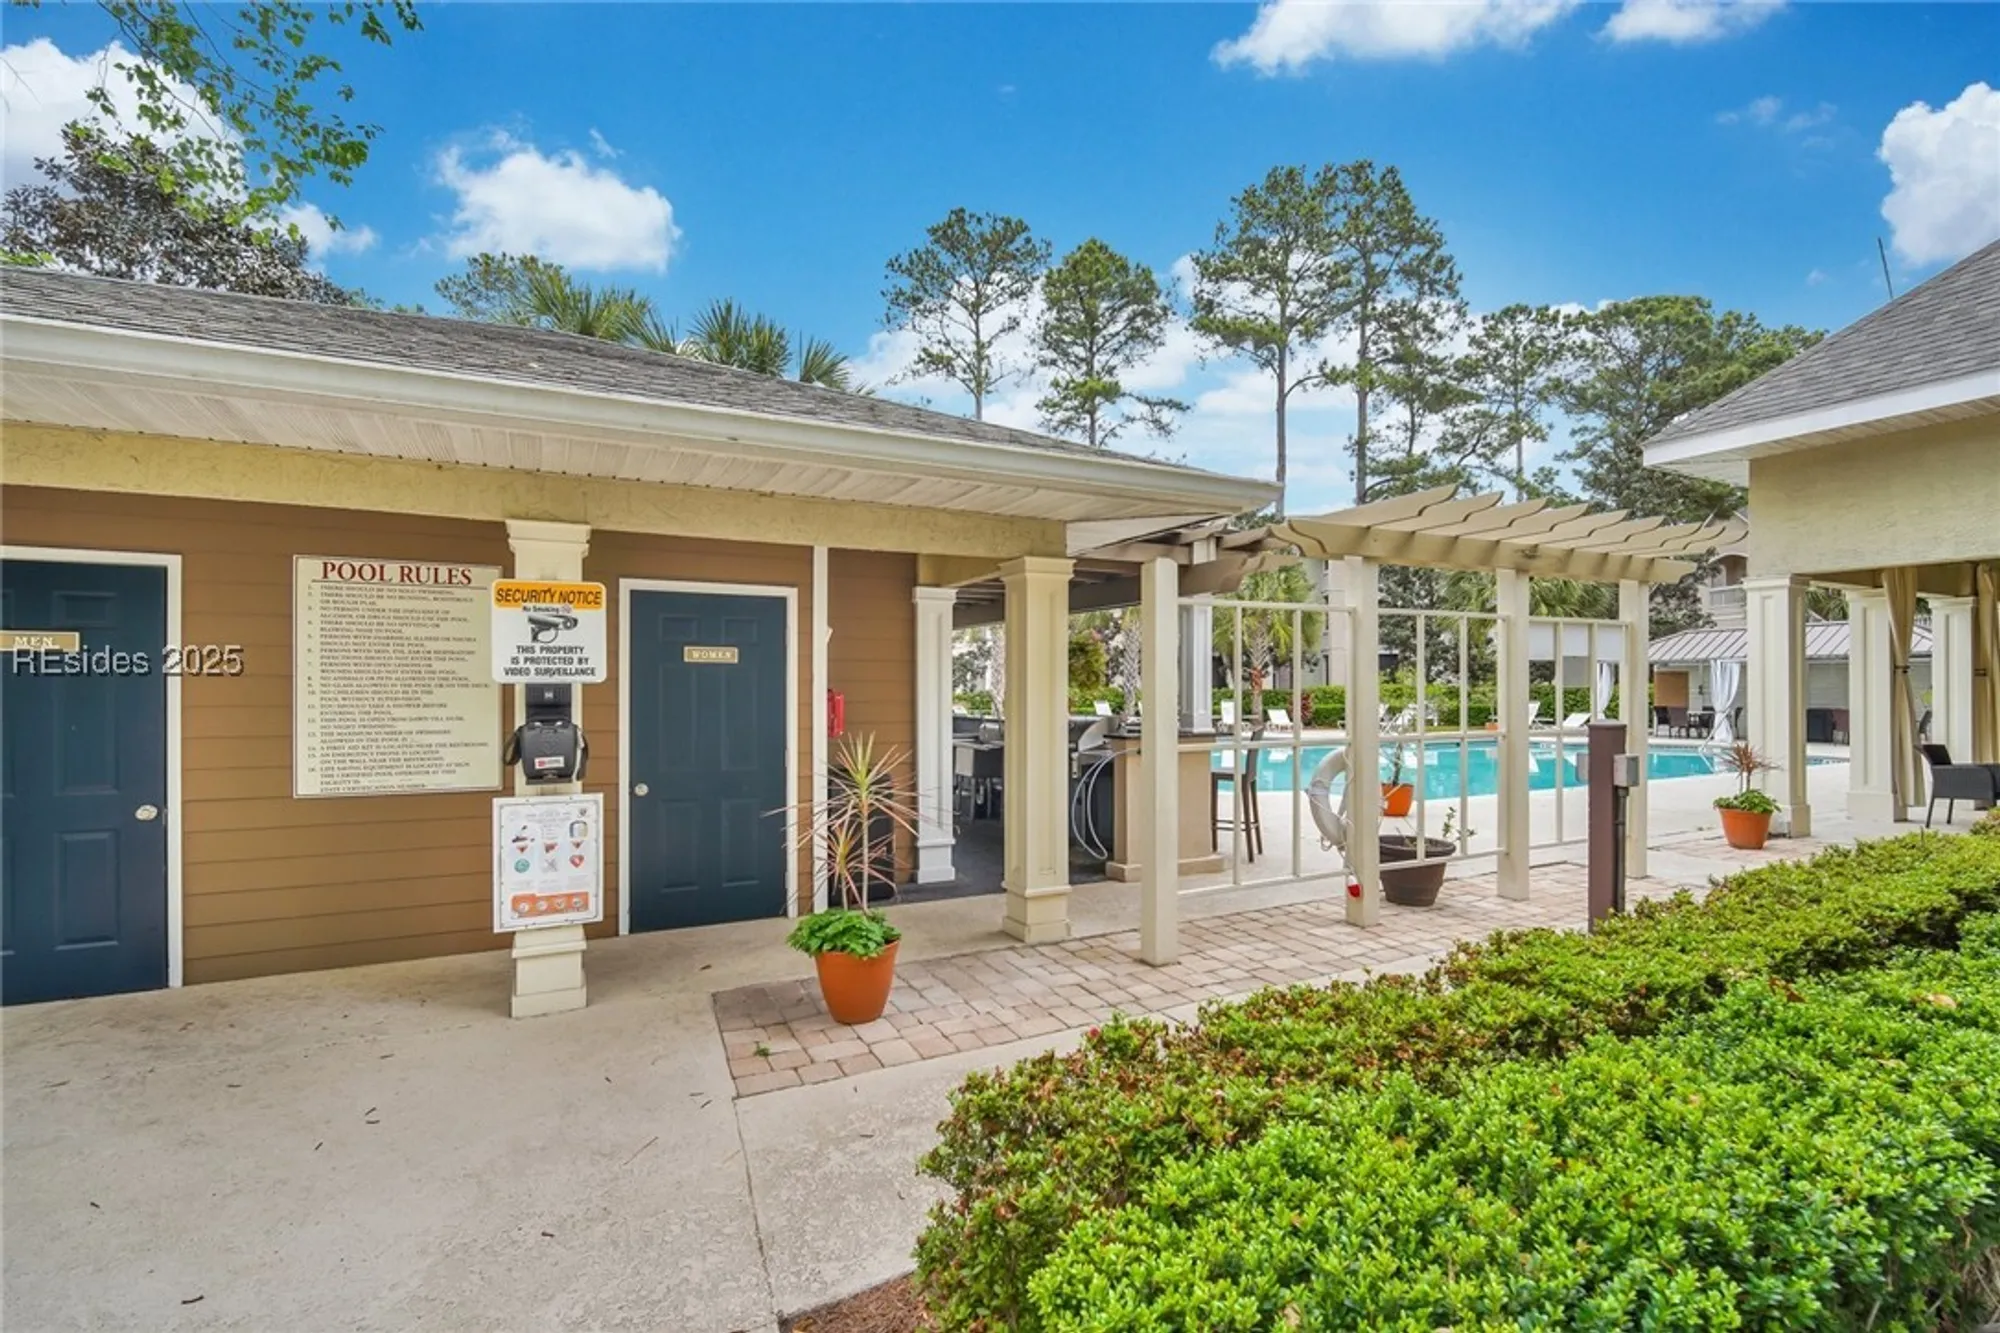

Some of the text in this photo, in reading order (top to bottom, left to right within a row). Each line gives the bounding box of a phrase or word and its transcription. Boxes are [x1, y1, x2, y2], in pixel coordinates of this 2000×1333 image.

[322, 562, 472, 586] POOL RULES
[496, 588, 602, 605] SECURITY NOTICE
[532, 606, 559, 614] Smoking
[13, 636, 54, 647] MEN
[516, 645, 584, 654] THIS PROPERTY
[692, 651, 732, 659] WOMEN
[510, 656, 589, 665] IS PROTECTED BY
[503, 667, 596, 676] VIDEO SURVEILLANCE
